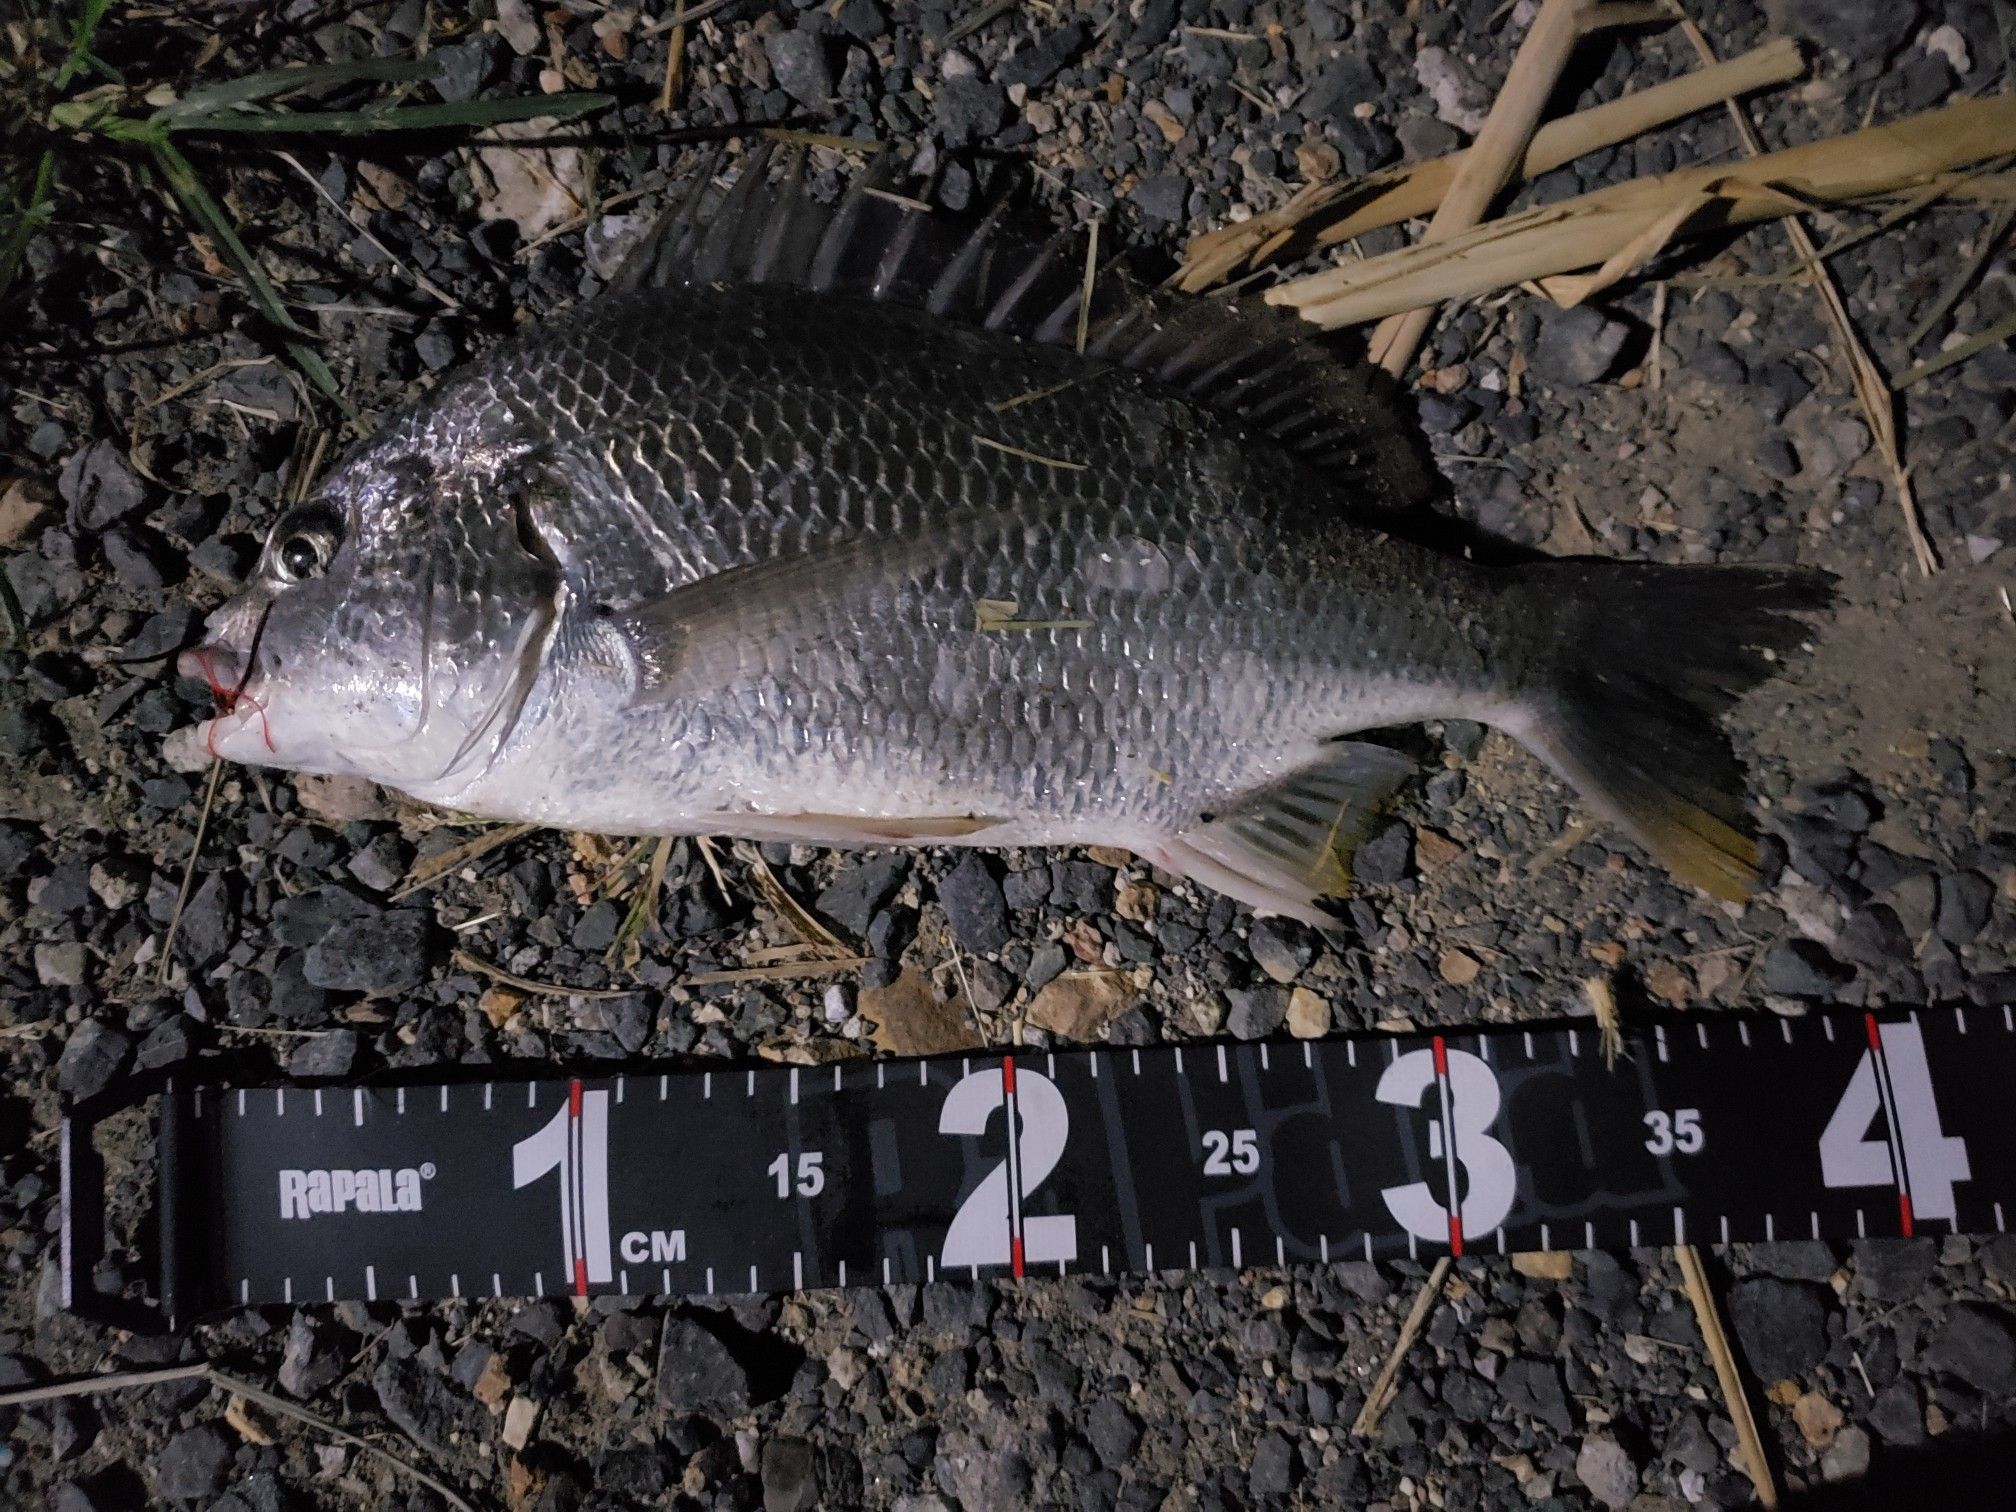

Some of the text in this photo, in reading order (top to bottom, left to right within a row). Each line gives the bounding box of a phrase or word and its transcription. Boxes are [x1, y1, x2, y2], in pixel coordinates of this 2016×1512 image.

[767, 1151, 826, 1199] 15
[938, 1067, 1078, 1268] 2
[1202, 1129, 1260, 1176] 25
[1375, 1047, 1517, 1242] 3
[1643, 1108, 1704, 1155] 35
[1818, 1012, 1972, 1221] 4
[512, 1089, 613, 1284] 1
[620, 1229, 687, 1264] CM
